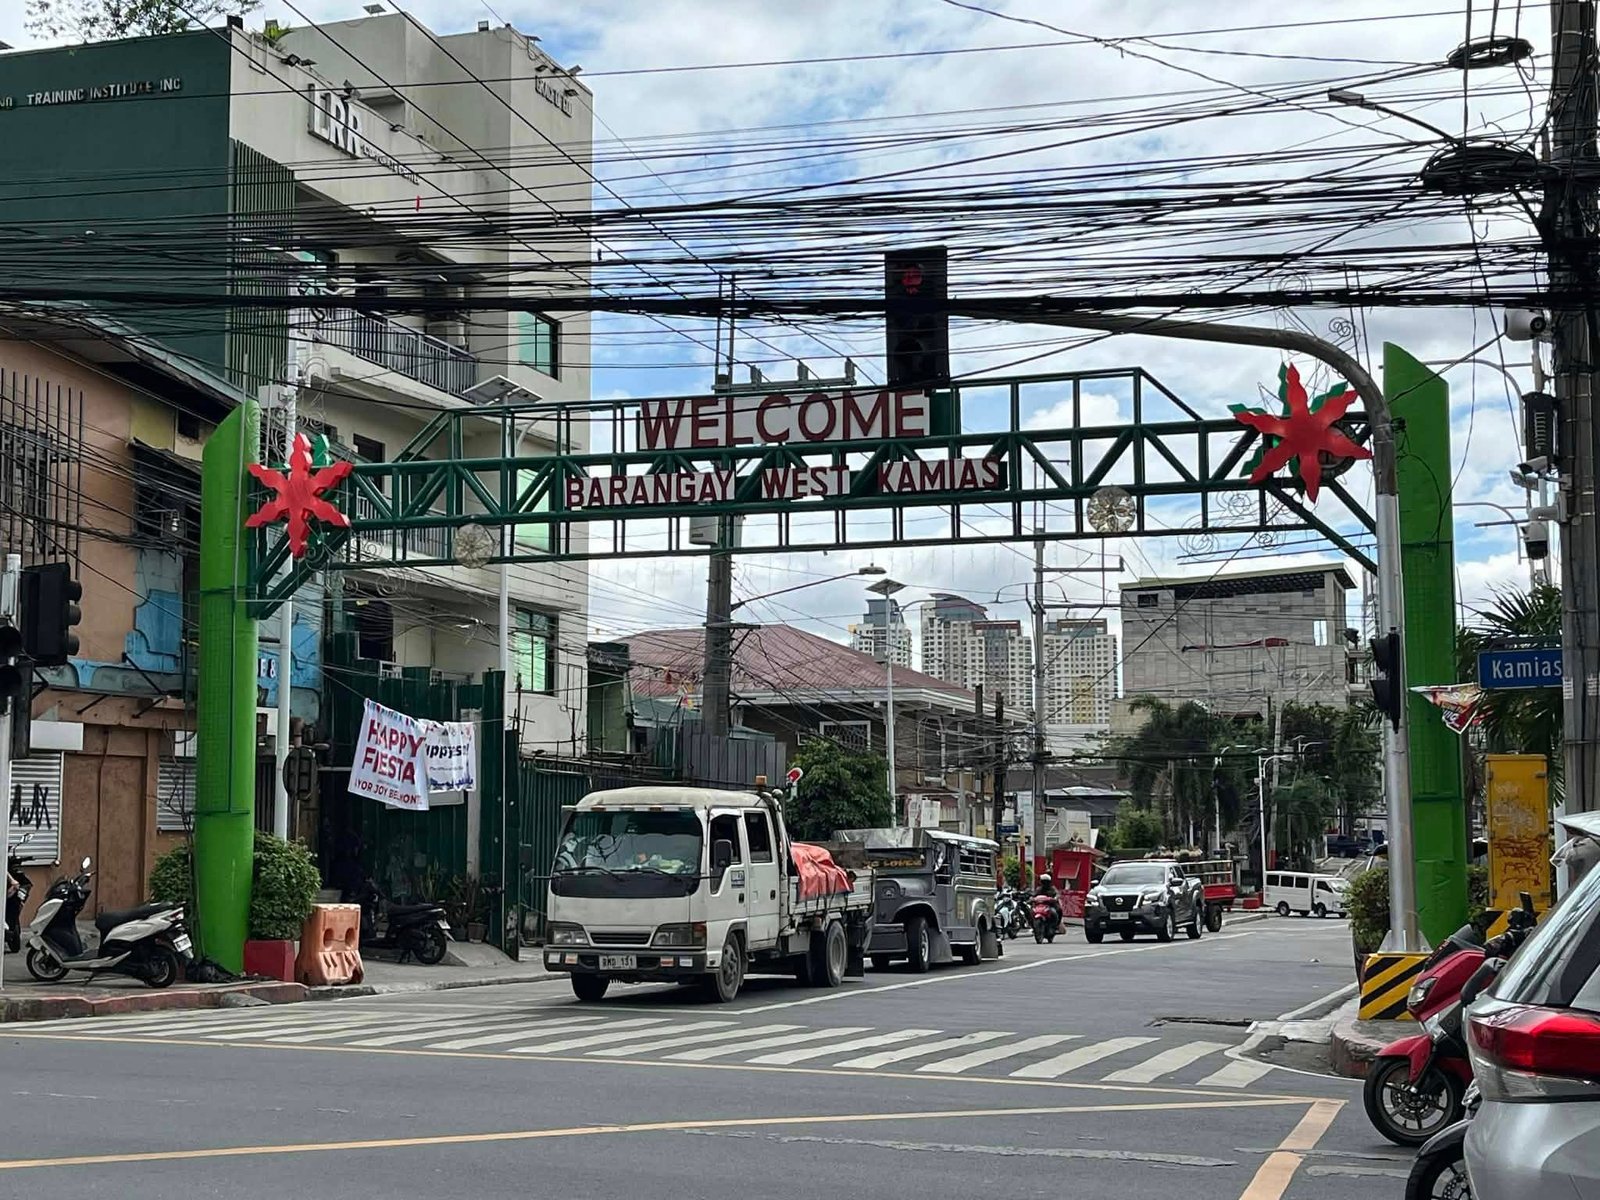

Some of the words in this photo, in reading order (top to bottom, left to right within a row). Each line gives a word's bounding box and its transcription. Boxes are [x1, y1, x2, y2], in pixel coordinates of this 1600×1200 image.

[160, 77, 181, 91] INC
[640, 389, 925, 450] WELCOME
[566, 470, 734, 509] BARANGAY
[761, 465, 849, 500] WEST
[877, 456, 1000, 493] KAMIAS
[1492, 656, 1562, 679] Kamias
[367, 719, 425, 758] HAPPY
[362, 746, 416, 784] FIESTA
